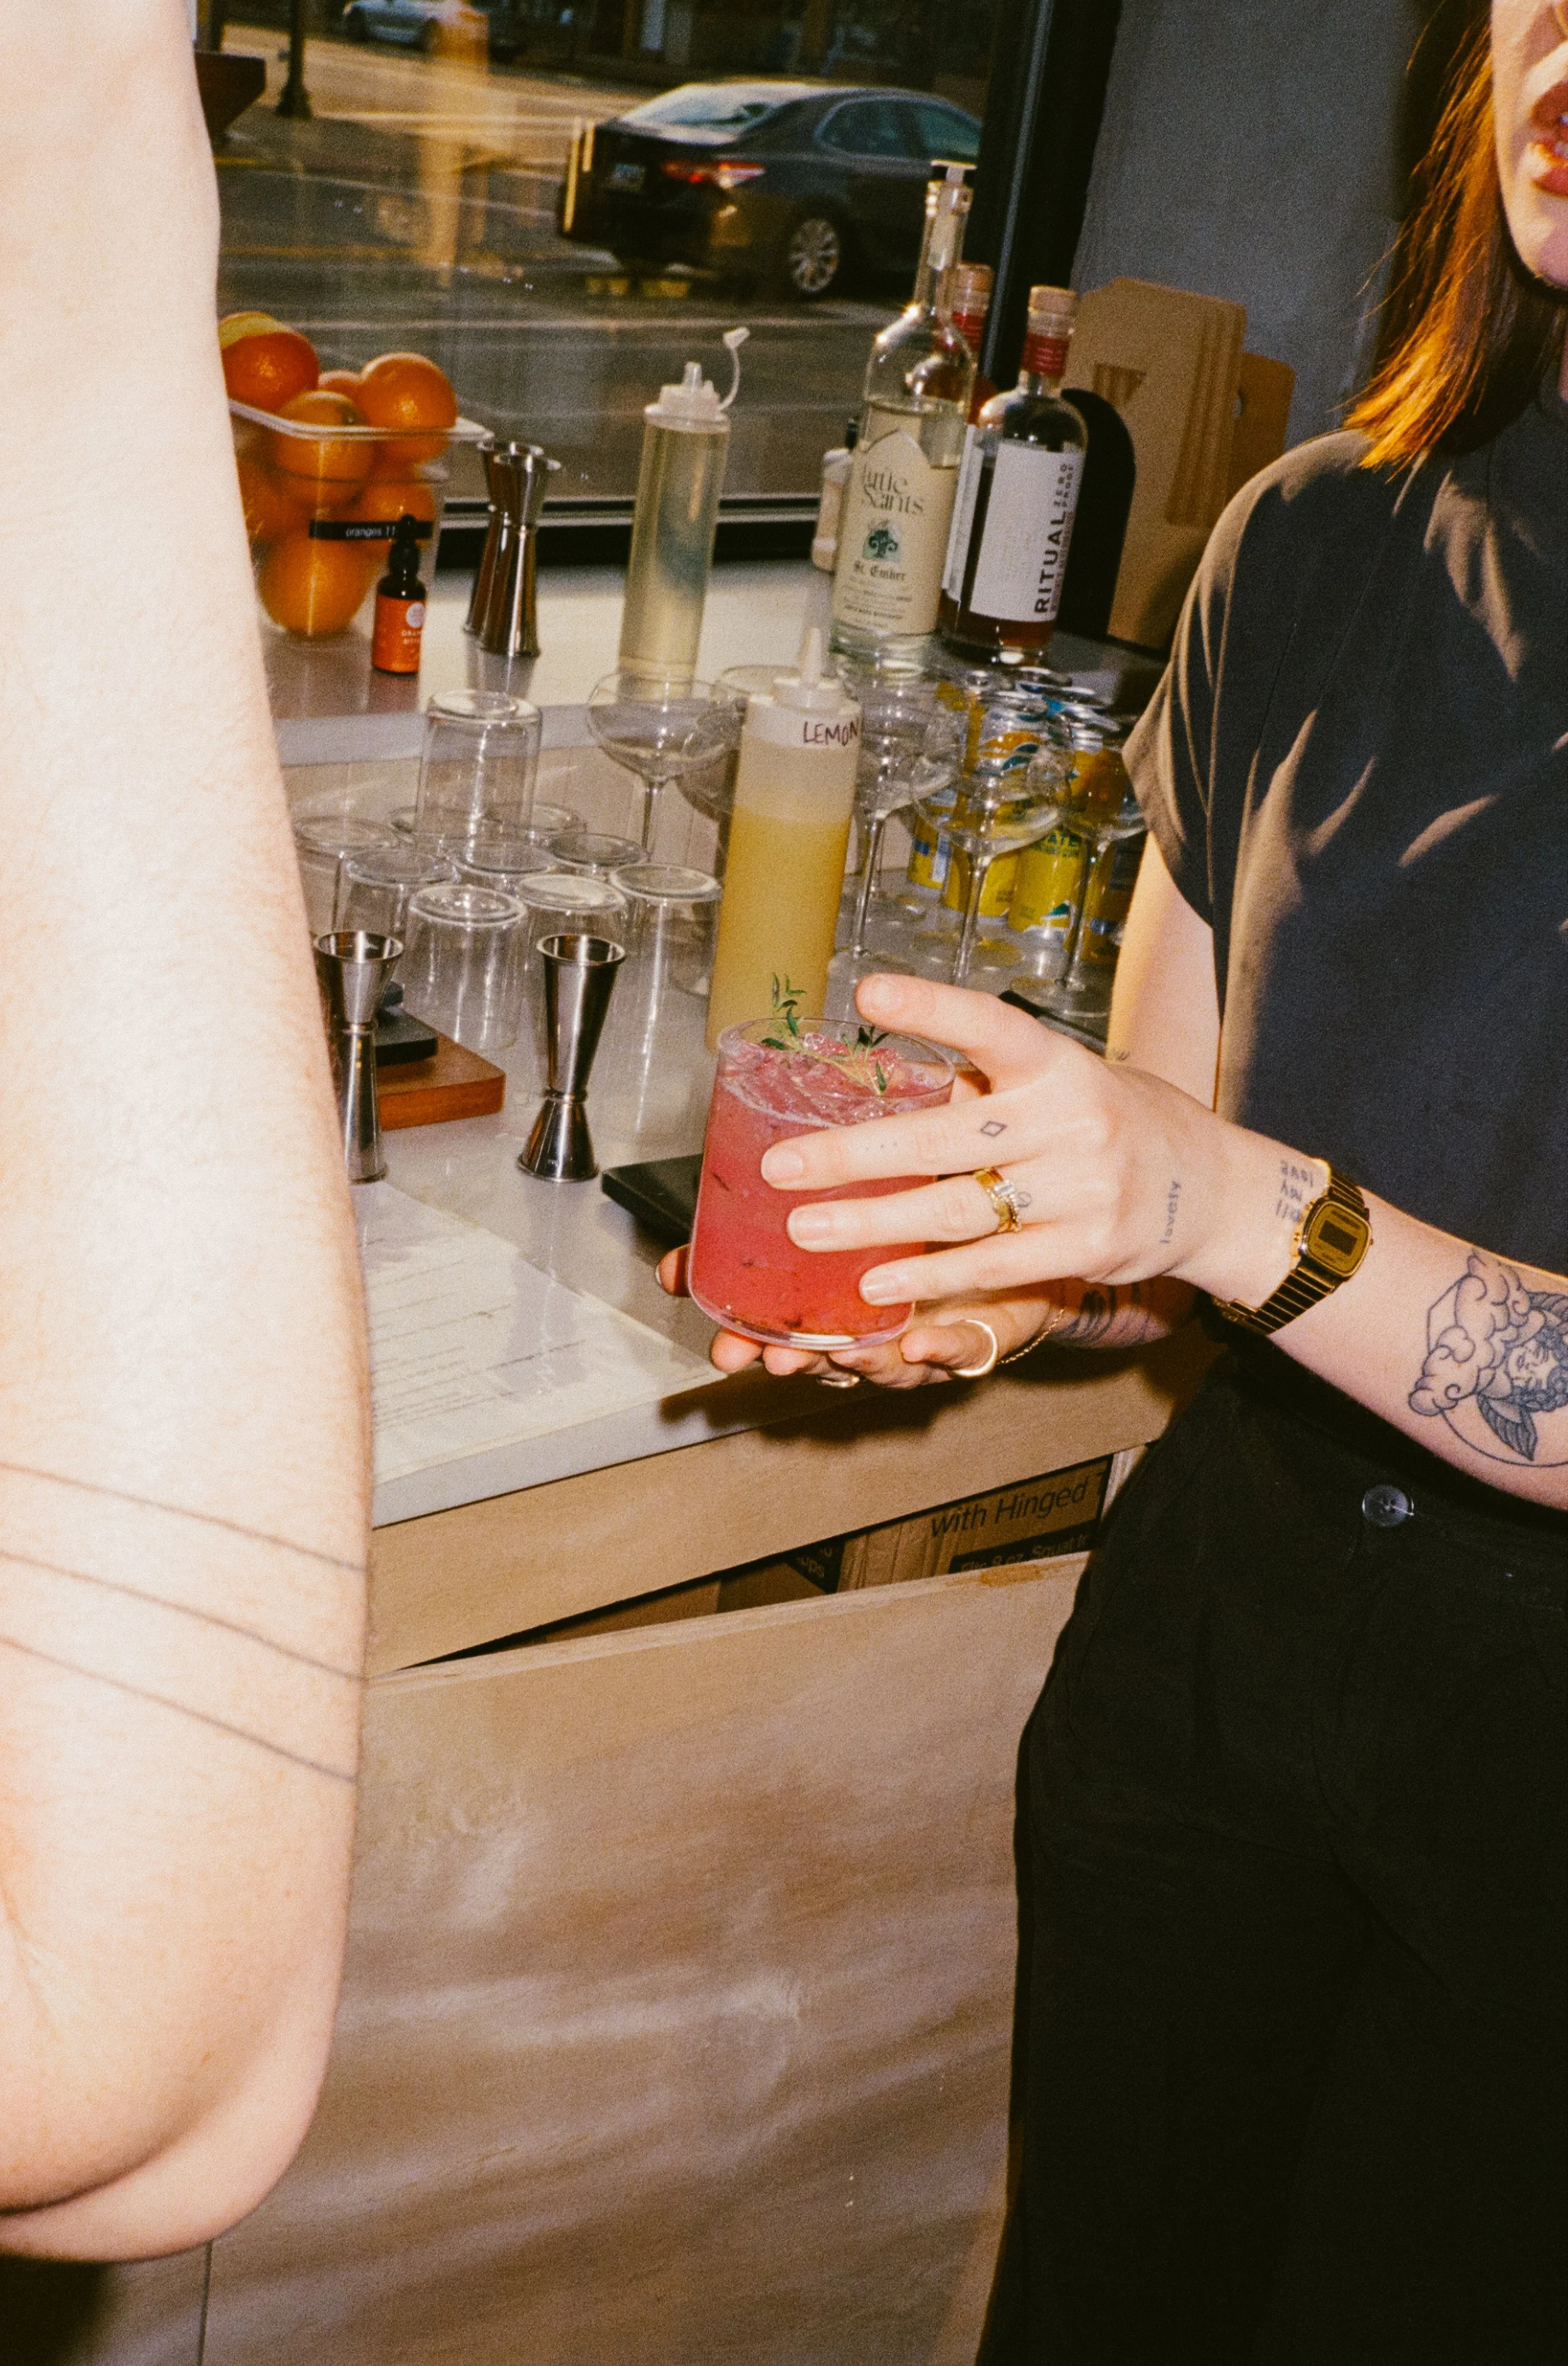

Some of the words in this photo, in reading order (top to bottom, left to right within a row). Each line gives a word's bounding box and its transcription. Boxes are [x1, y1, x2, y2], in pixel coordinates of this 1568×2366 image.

[1053, 464, 1067, 506] ZERO
[1061, 465, 1074, 507] PROOF
[346, 528, 382, 539] oranges
[1034, 511, 1066, 613] RITUAL
[803, 718, 859, 746] LEMON
[931, 1505, 988, 1537] with
[994, 1475, 1090, 1524] Hinged
